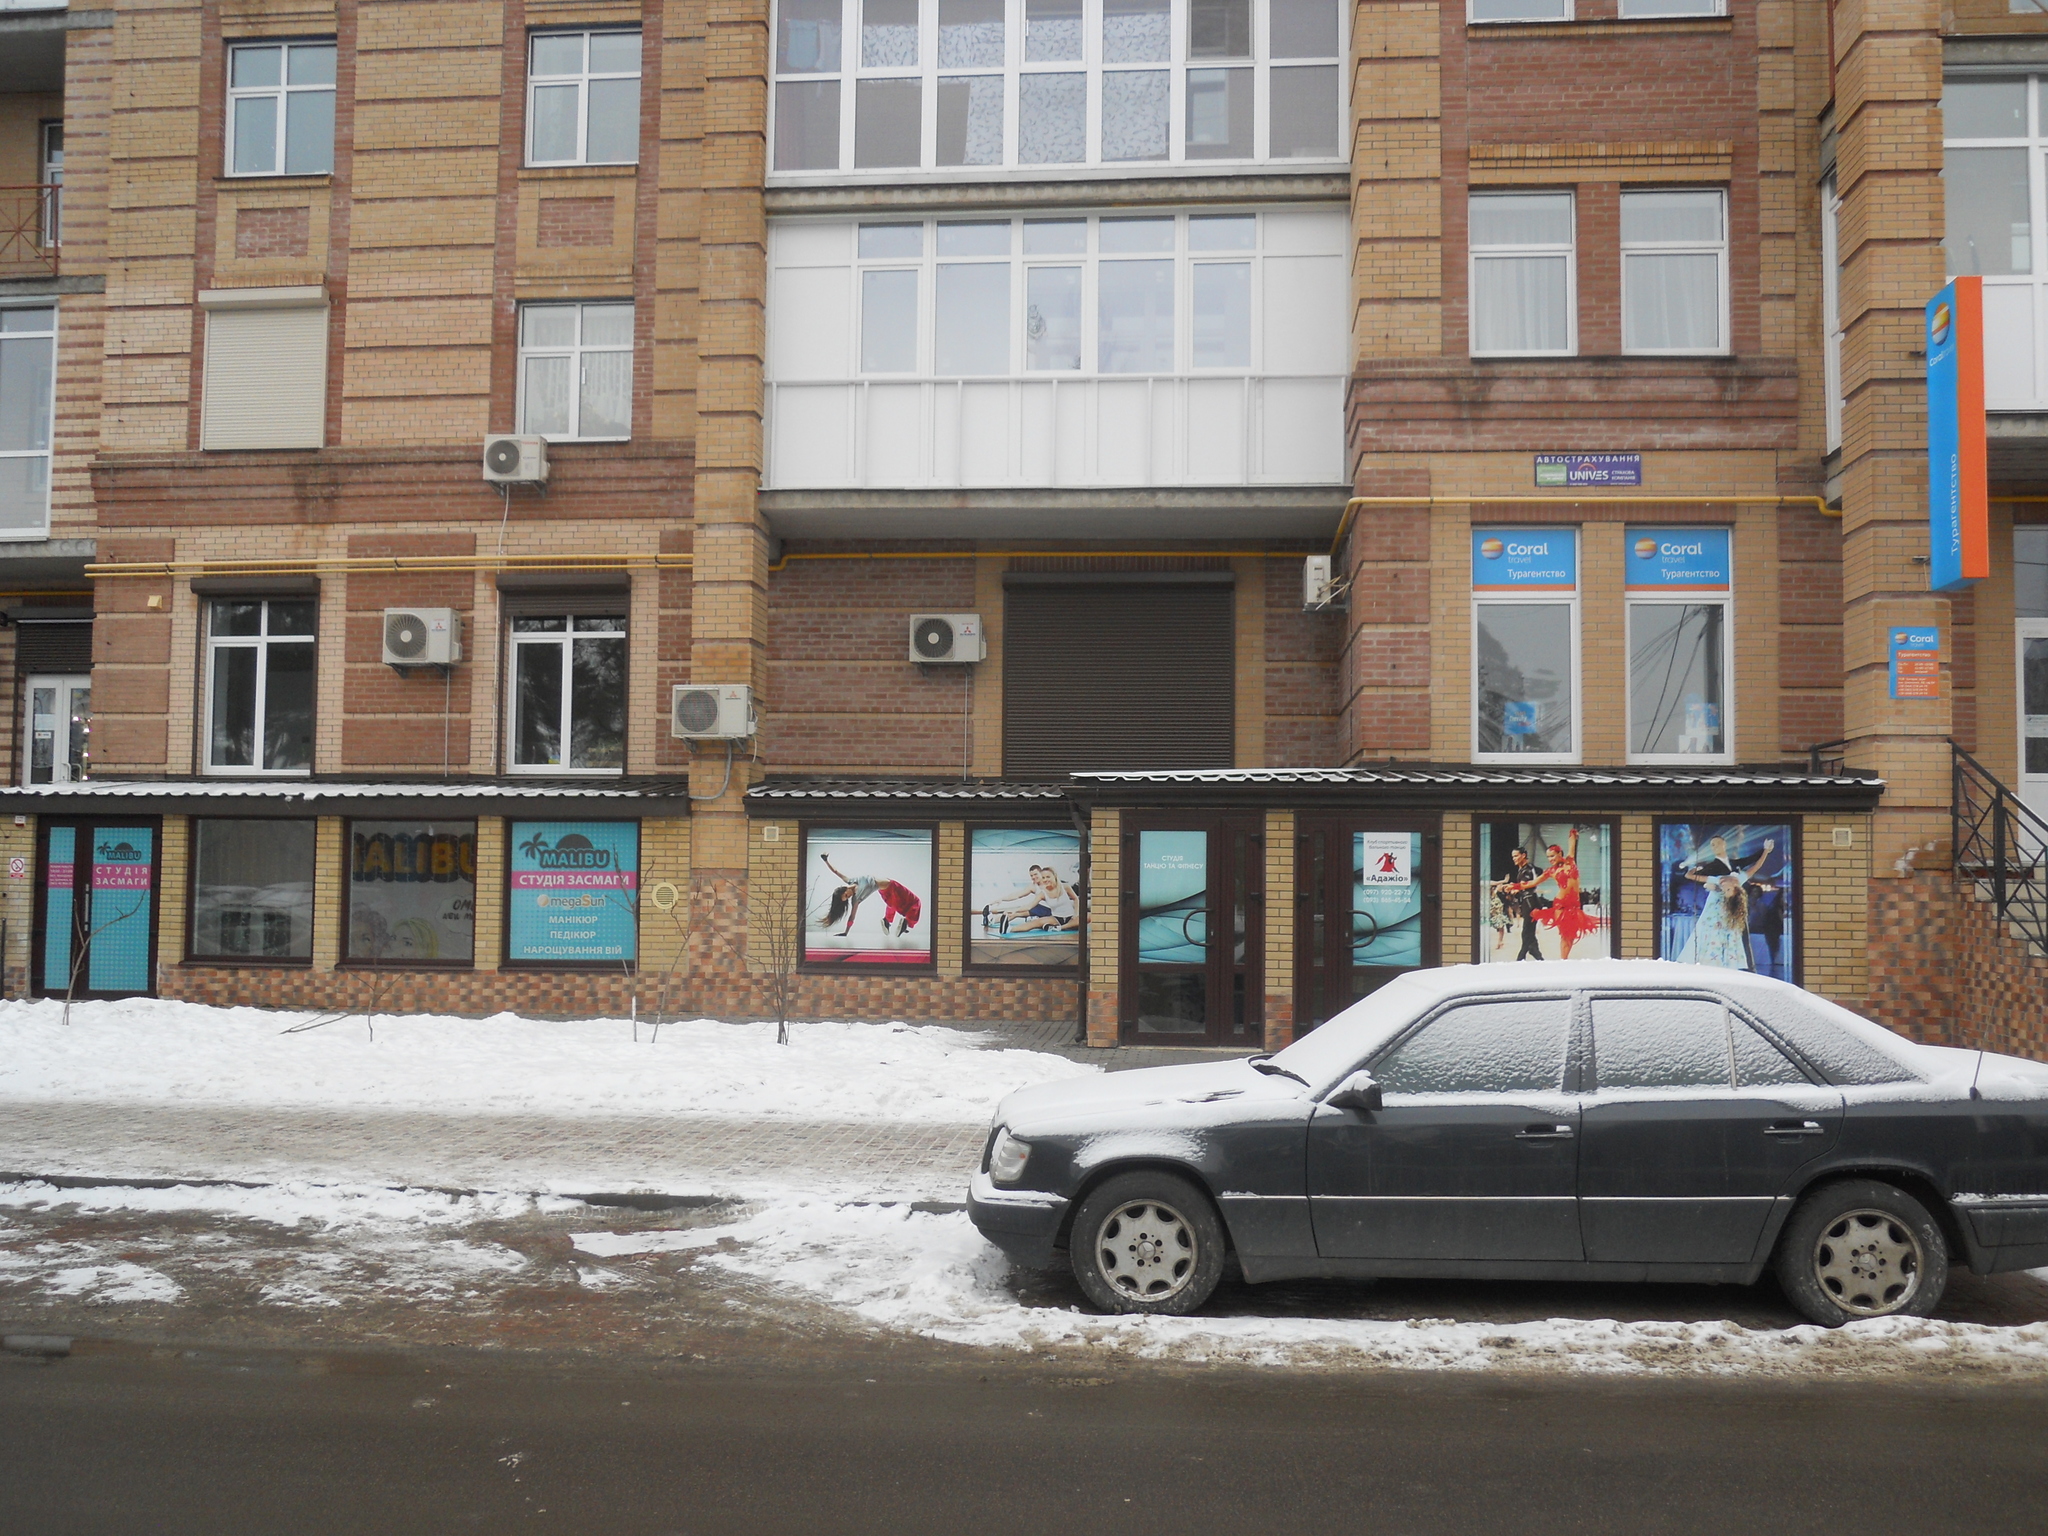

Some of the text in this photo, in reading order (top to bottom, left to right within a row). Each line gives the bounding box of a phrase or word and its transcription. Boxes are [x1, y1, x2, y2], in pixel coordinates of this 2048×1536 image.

[1536, 455, 1640, 464] АВТОСТРАХУВАННЯ
[1569, 470, 1609, 481] UNIVES
[1951, 453, 1959, 556] Турагентство
[1506, 542, 1549, 555] Coral
[1660, 542, 1703, 555] Coral
[1507, 556, 1532, 564] travel
[1661, 556, 1686, 564] travel
[1506, 568, 1566, 580] Турагентство
[1660, 568, 1720, 580] Турагентство
[1909, 635, 1934, 643] Coral
[107, 850, 142, 860] MALIBU
[541, 851, 609, 867] MALIBU
[95, 866, 148, 876] СТУДІЯ
[95, 877, 148, 886] ЗАСМАГИ
[518, 874, 630, 887] СТУДІЯ ЗАСМАГИ
[1366, 874, 1409, 883] «Адажіо»
[548, 916, 598, 924] МАНІКЮР
[550, 931, 597, 940] ПЕДІКЮР
[523, 945, 622, 955] НАРОЩУВАННЯ ВІЙ
